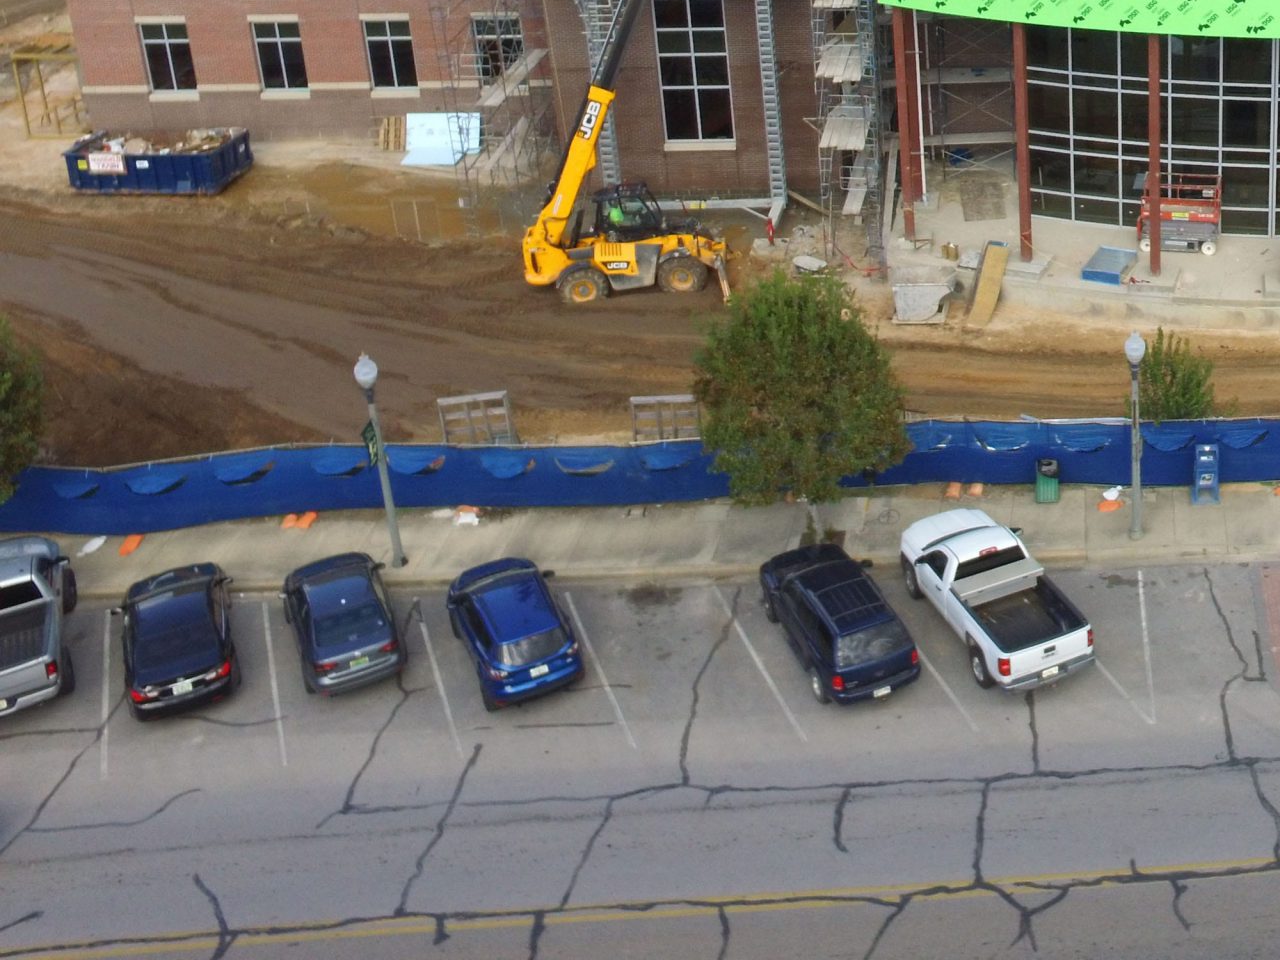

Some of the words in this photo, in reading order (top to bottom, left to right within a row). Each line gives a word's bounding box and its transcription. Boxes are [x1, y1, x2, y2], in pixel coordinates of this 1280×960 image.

[1177, 1, 1189, 11] USG
[1225, 3, 1237, 13] USG
[1128, 10, 1139, 19] USG
[1207, 13, 1219, 23] USG
[1262, 15, 1274, 25] USG
[580, 101, 601, 139] JCB
